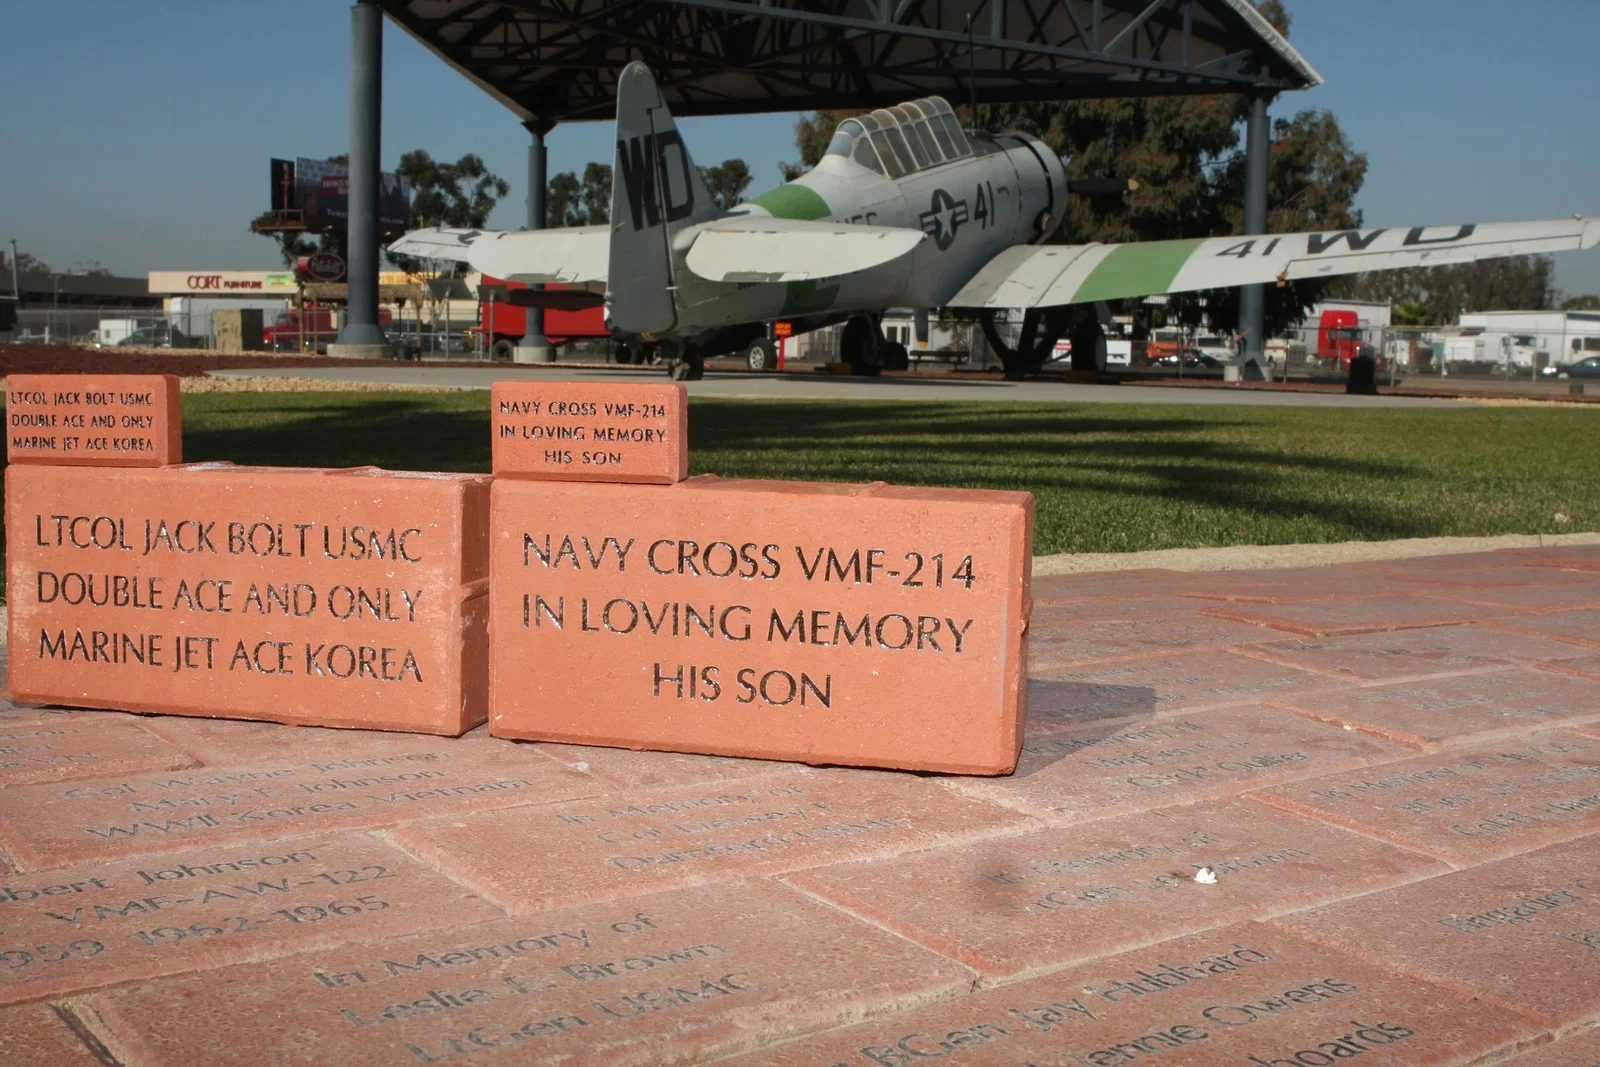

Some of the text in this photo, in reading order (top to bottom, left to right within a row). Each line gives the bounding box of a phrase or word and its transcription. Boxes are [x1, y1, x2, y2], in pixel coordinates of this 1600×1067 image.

[617, 130, 694, 232] WD
[187, 275, 222, 289] CORT
[10, 390, 154, 408] LTCOL JACK BOLT USMC
[11, 413, 154, 430] DOUBLE ACE AND ONLY
[500, 400, 666, 418] NAVY CROSS VMF-214
[12, 436, 155, 453] MARINE JET ACE KOREA
[499, 424, 667, 444] IN LOVING MEMORY
[543, 449, 623, 467] HIS SON
[36, 514, 423, 564] LTCOL JACK BOLT USMC
[522, 532, 977, 590] NAVY CROSS VMF-214
[37, 571, 422, 623] DOUBLE ACE AND ONLY
[522, 593, 564, 631] IN
[580, 597, 752, 643] LOVING
[766, 608, 975, 654] MEMORY
[38, 628, 424, 683] MARINE JET ACE KOREA
[653, 662, 832, 709] HIS SON
[299, 768, 447, 796] Johnson
[86, 779, 533, 838] WWII Korea Vietnam
[605, 793, 756, 820] Memory
[137, 852, 316, 886] Johnson
[129, 895, 390, 946] 1962-1965
[313, 911, 658, 989] In Memory of
[340, 988, 494, 1028] Leslie
[560, 943, 729, 983] Brown
[592, 972, 768, 1018] USMC
[1008, 998, 1098, 1032] Jay
[1084, 942, 1272, 1003] Hubbard
[1201, 976, 1357, 1026] Owens
